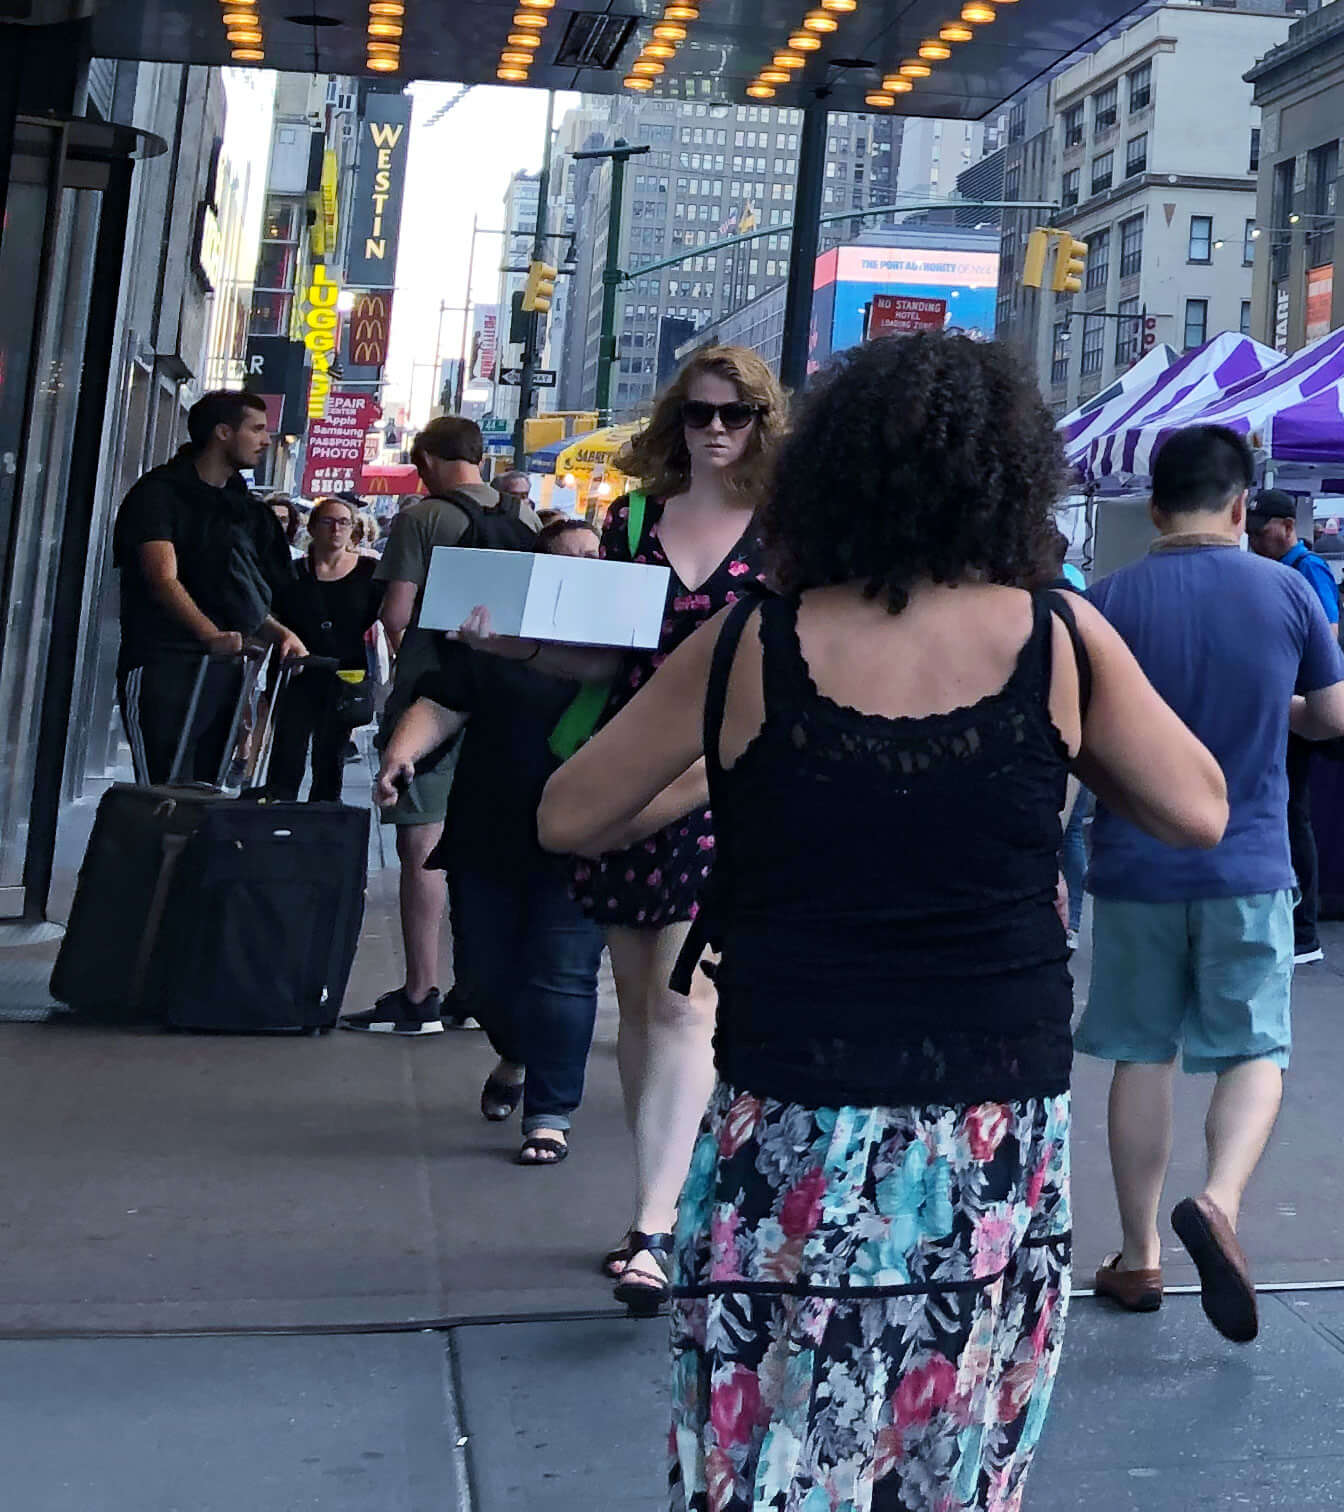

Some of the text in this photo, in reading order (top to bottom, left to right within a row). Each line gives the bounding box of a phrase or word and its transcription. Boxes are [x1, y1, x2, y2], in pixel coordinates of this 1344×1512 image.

[365, 122, 403, 260] WESTIN
[878, 299, 941, 312] NO STANDING
[896, 311, 920, 320] HOTEL
[305, 264, 338, 419] LUGGAGE
[328, 397, 366, 408] EPAIR
[325, 416, 357, 426] Apple
[313, 424, 364, 437] Samsung
[309, 437, 363, 448] PASSPORT
[311, 448, 359, 459] PHOTO
[311, 479, 354, 493] SHOP
